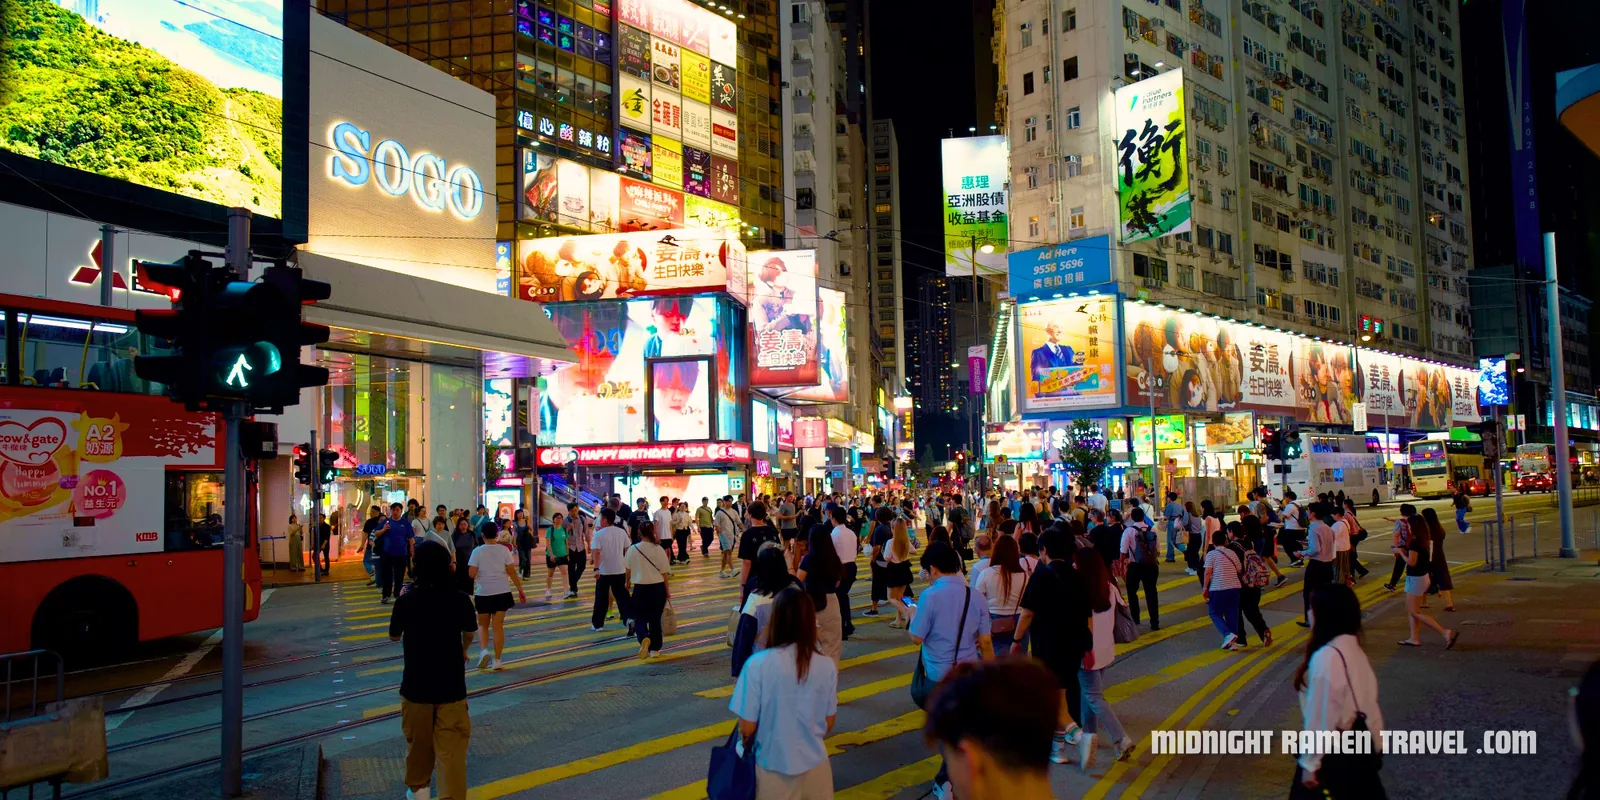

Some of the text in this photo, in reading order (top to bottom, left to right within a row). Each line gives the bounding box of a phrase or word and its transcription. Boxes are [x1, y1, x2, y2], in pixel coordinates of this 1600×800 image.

[1142, 91, 1172, 105] Partners
[333, 122, 484, 219] SOGO
[961, 175, 990, 190] 惠理
[1527, 161, 1536, 209] 2388
[947, 191, 1005, 208] 亞洲股債
[948, 209, 1005, 226] 收益基金
[656, 244, 701, 263] 姜濤
[1038, 247, 1078, 261] Ad Here
[653, 263, 704, 280] 生日快樂
[1033, 258, 1084, 275] 9556 5696
[1033, 271, 1084, 290] 廣告位招租
[760, 329, 804, 351] 姜濤
[757, 352, 807, 367] 生日快樂
[1249, 340, 1279, 376] 姜濤
[1369, 363, 1392, 392] 姜濤
[1249, 375, 1283, 398] 生日快樂
[86, 424, 114, 441] A2
[85, 441, 114, 455] 奶源
[580, 446, 704, 461] HAPPY BIRTHDAY 0430
[15, 466, 46, 478] Happy
[356, 464, 386, 475] SOGO
[84, 480, 118, 497] NO.1
[84, 497, 117, 509] 益生元
[135, 532, 158, 542] KMB
